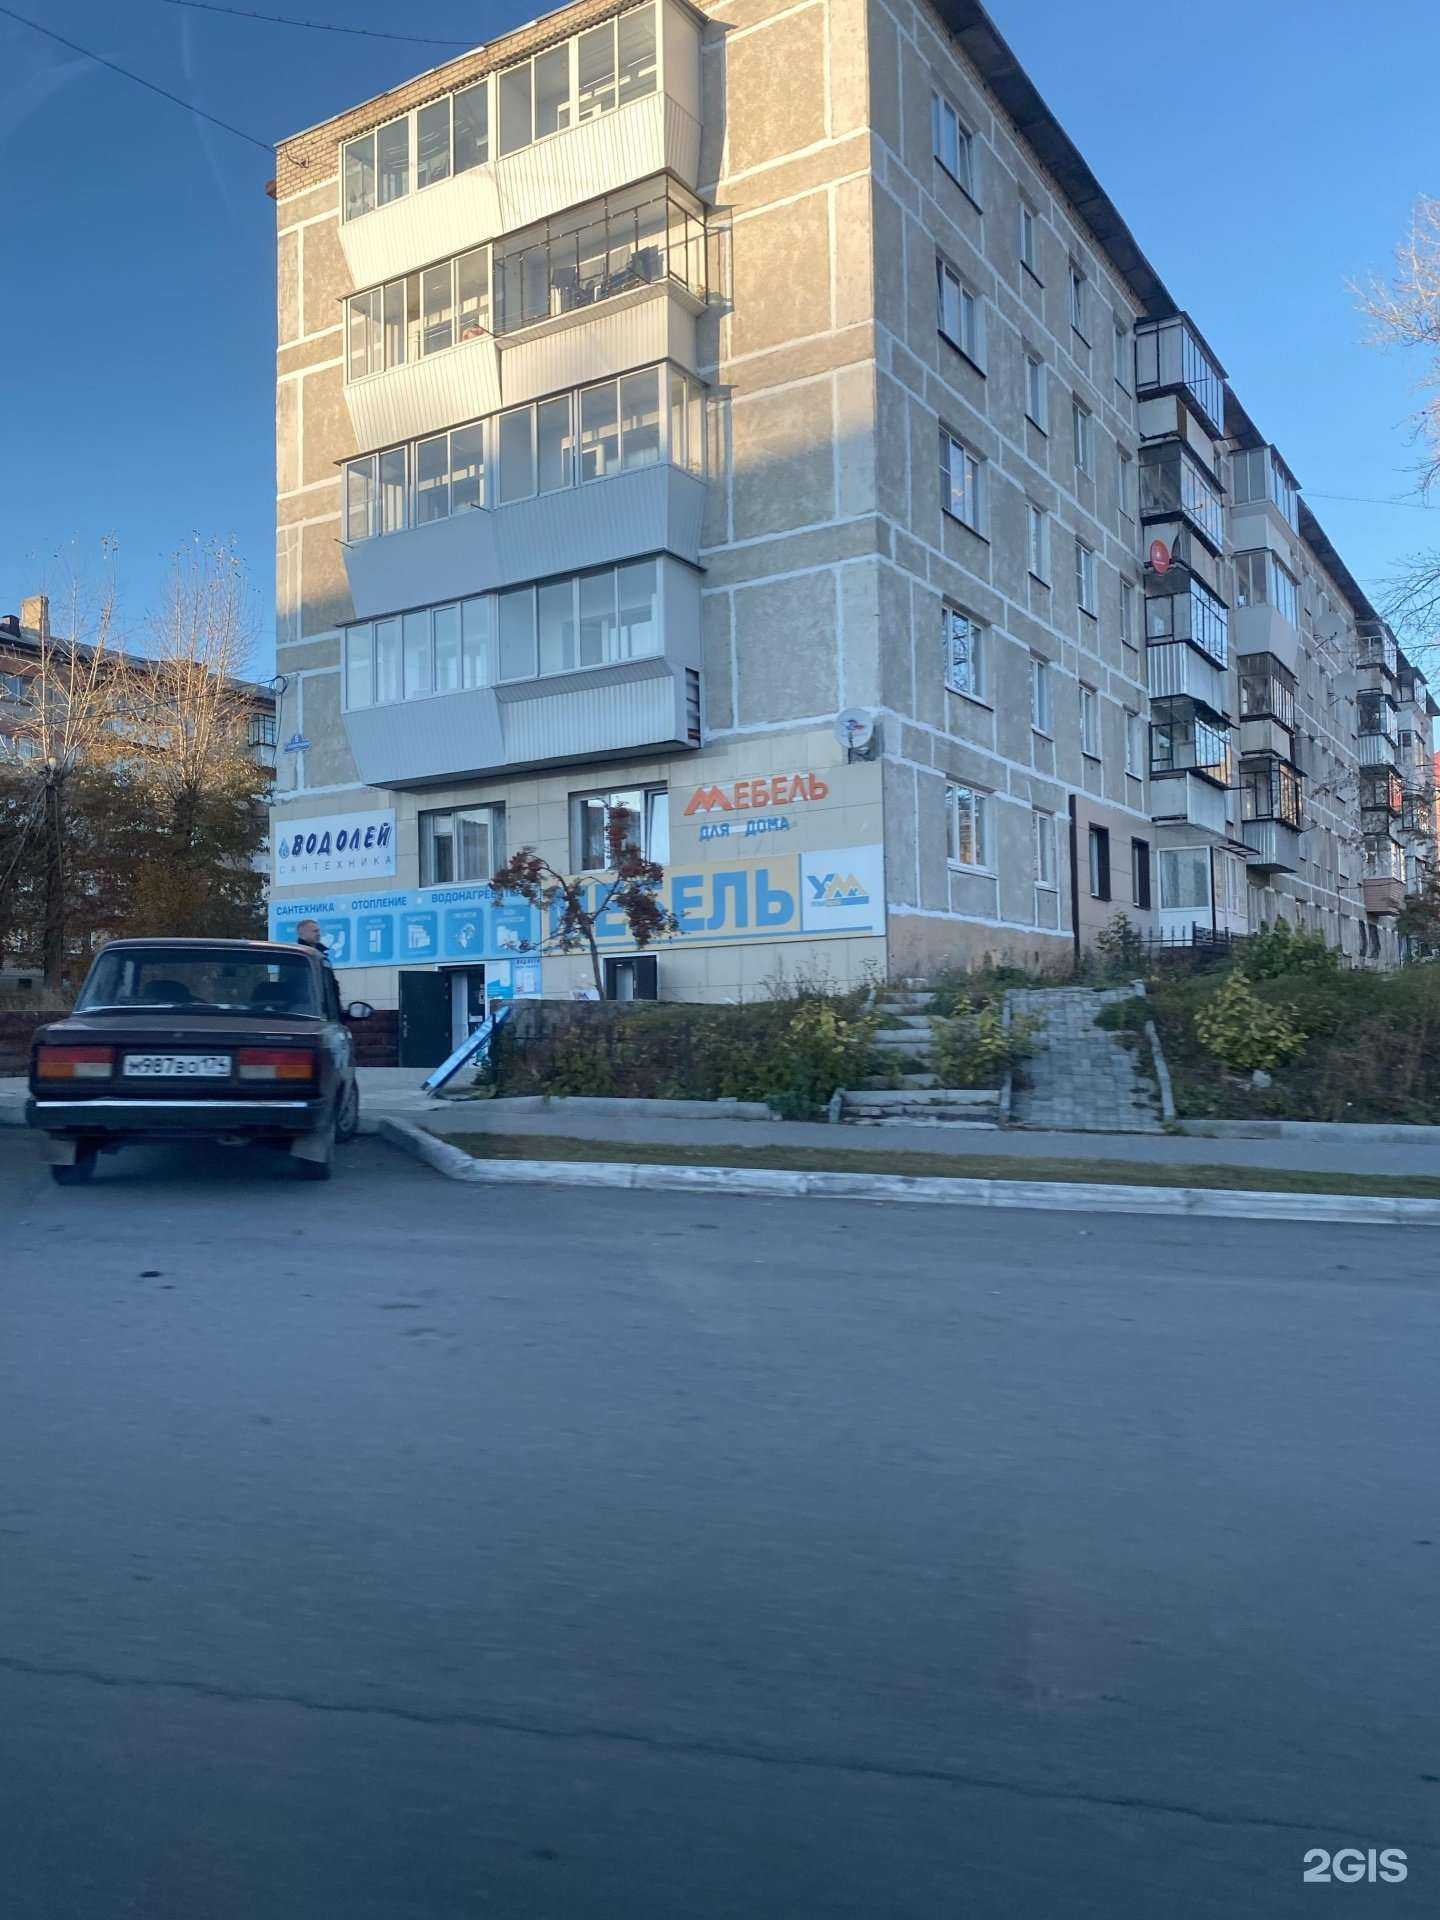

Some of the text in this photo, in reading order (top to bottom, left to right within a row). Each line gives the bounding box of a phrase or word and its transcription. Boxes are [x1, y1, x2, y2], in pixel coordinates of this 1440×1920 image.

[684, 772, 828, 816] МЕБЕЛЬ
[291, 822, 392, 857] ВОДОЛЕЙ
[699, 816, 791, 842] ДЛЯ ДОМА
[279, 855, 392, 875] САНТЕХНИКА
[276, 902, 335, 917] САНТЕХНИКА
[351, 895, 407, 910] ОТОПЛЕНИЕ
